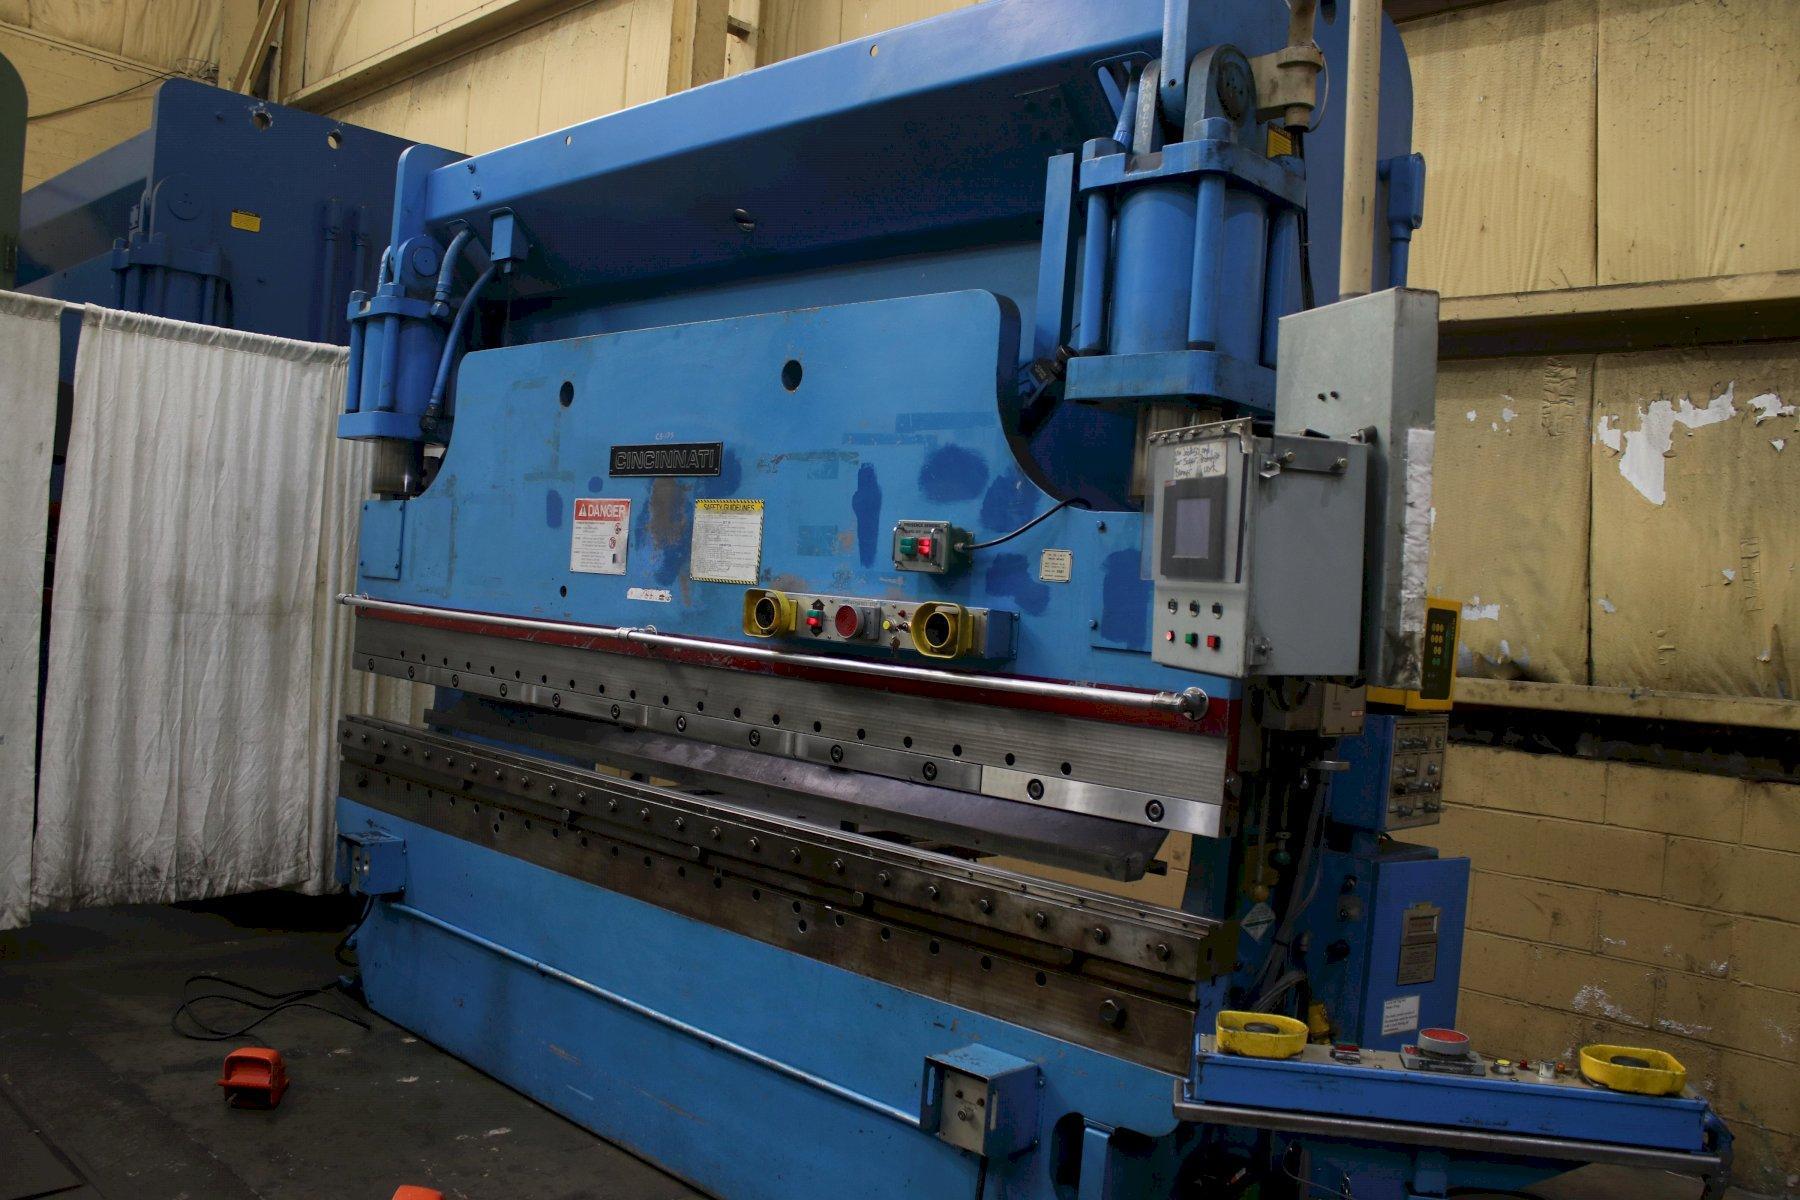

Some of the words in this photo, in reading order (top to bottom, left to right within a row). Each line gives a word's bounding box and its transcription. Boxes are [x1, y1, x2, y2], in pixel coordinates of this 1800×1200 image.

[614, 449, 715, 469] CINCINNATI
[587, 503, 625, 517] DANGER
[703, 502, 722, 511] SAFETY
[723, 503, 755, 512] GUIDELINES
